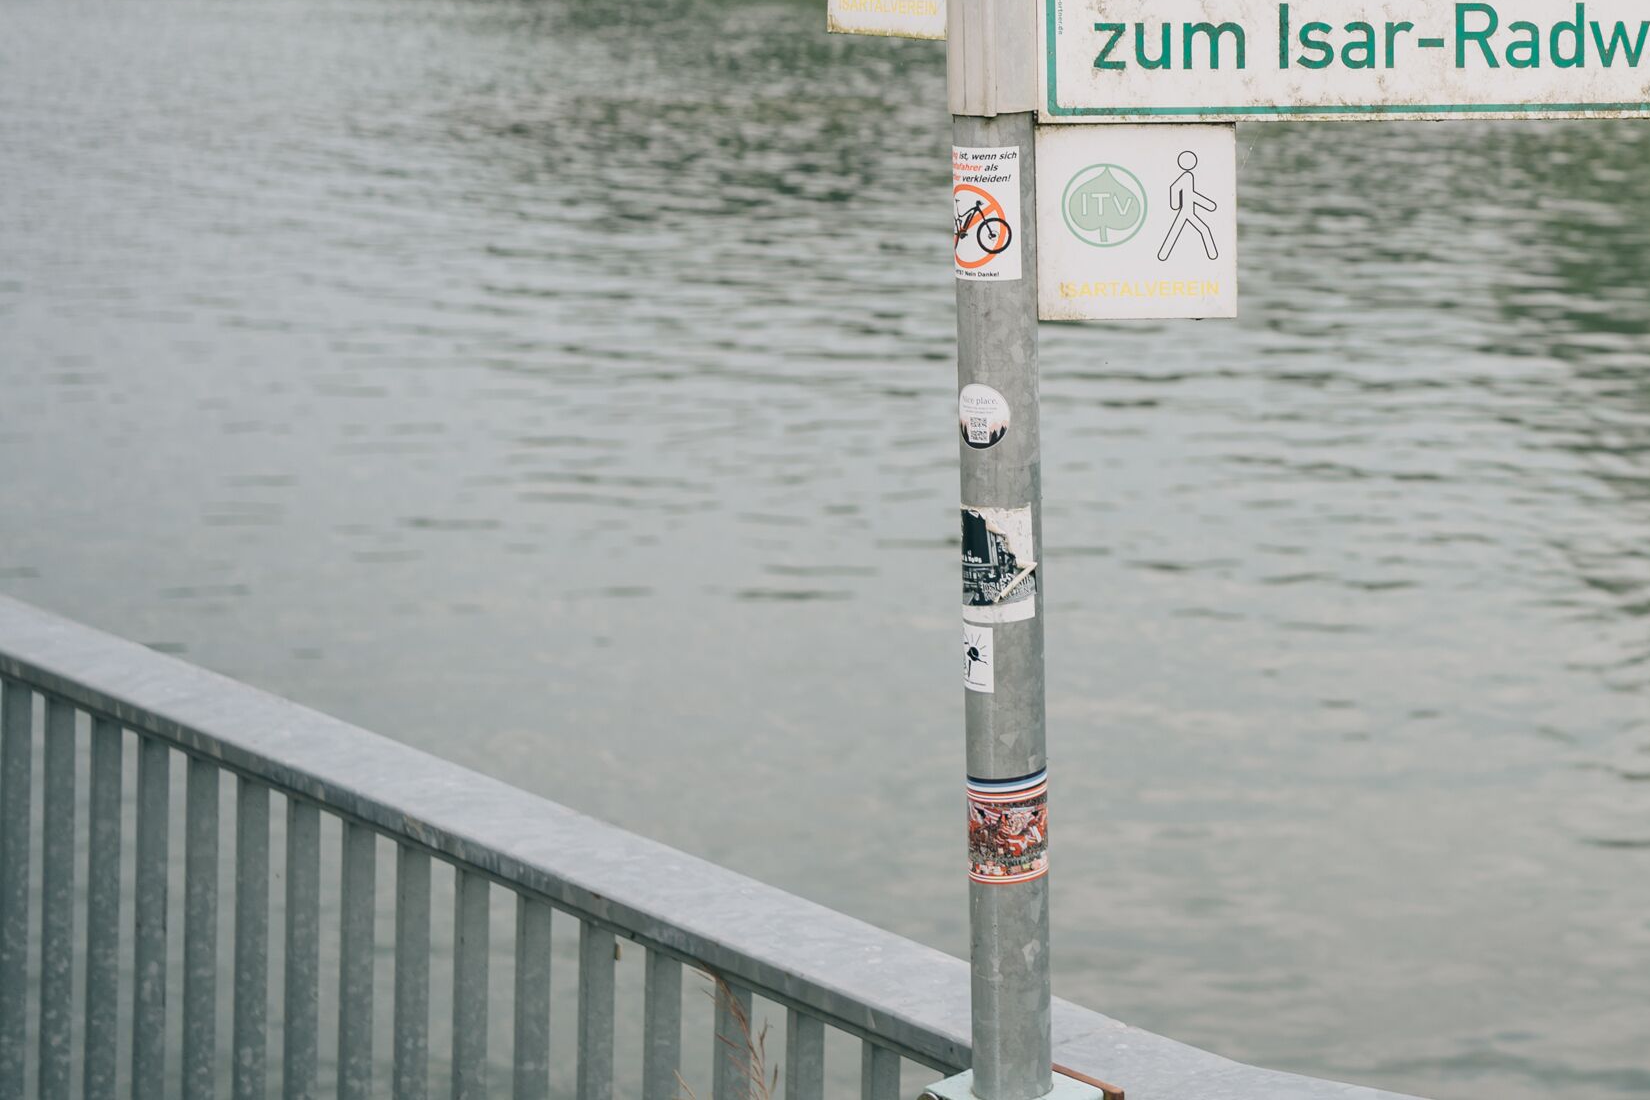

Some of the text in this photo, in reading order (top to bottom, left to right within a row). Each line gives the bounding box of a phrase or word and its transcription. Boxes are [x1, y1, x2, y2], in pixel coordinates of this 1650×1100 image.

[1094, 21, 1246, 70] zum
[999, 151, 1017, 160] sich
[984, 163, 999, 172] als
[962, 174, 1011, 183] verkleiden!
[1080, 192, 1134, 217] ITV
[1059, 279, 1220, 298] ISARTALVEREIN
